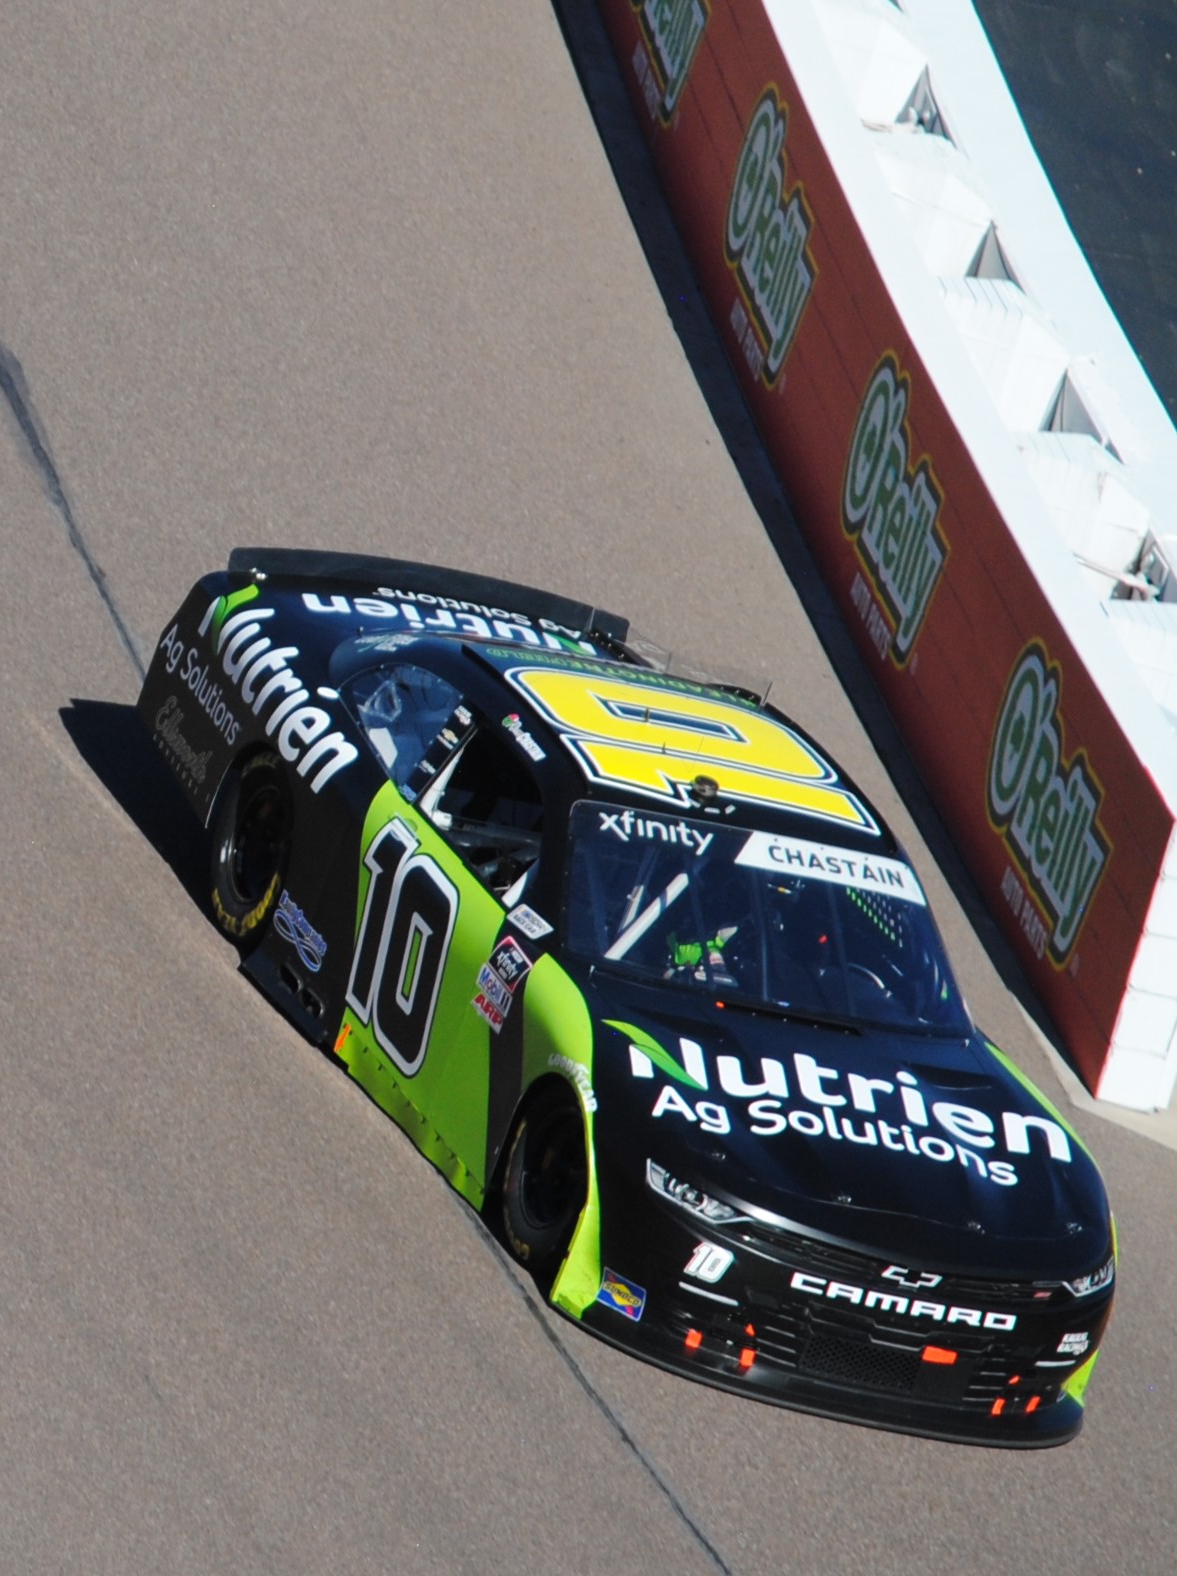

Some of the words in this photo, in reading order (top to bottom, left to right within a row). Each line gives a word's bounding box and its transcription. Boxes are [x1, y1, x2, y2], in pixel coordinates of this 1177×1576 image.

[844, 365, 943, 652] O'Reilly
[301, 591, 597, 656] Nutrien
[377, 586, 534, 626] Solutions
[539, 617, 583, 638] Ag
[159, 624, 183, 673] Ag
[179, 646, 241, 746] Solutions
[198, 586, 359, 794] Nutrien
[504, 666, 883, 837] 10
[990, 654, 1106, 952] O'Reilly
[600, 811, 713, 856] xfinity
[767, 844, 906, 889] CHASTAIN
[345, 815, 461, 1078] 10
[474, 993, 503, 1025] ARP
[480, 966, 504, 1002] Mobil
[547, 1053, 598, 1113] GOODYEAR
[626, 1030, 1073, 1163] Nutrien
[651, 1085, 731, 1135] Ag
[748, 1099, 1018, 1187] Solutions
[603, 1281, 642, 1307] SUNOCO
[683, 1240, 735, 1283] 10
[789, 1271, 1017, 1332] CAMARO
